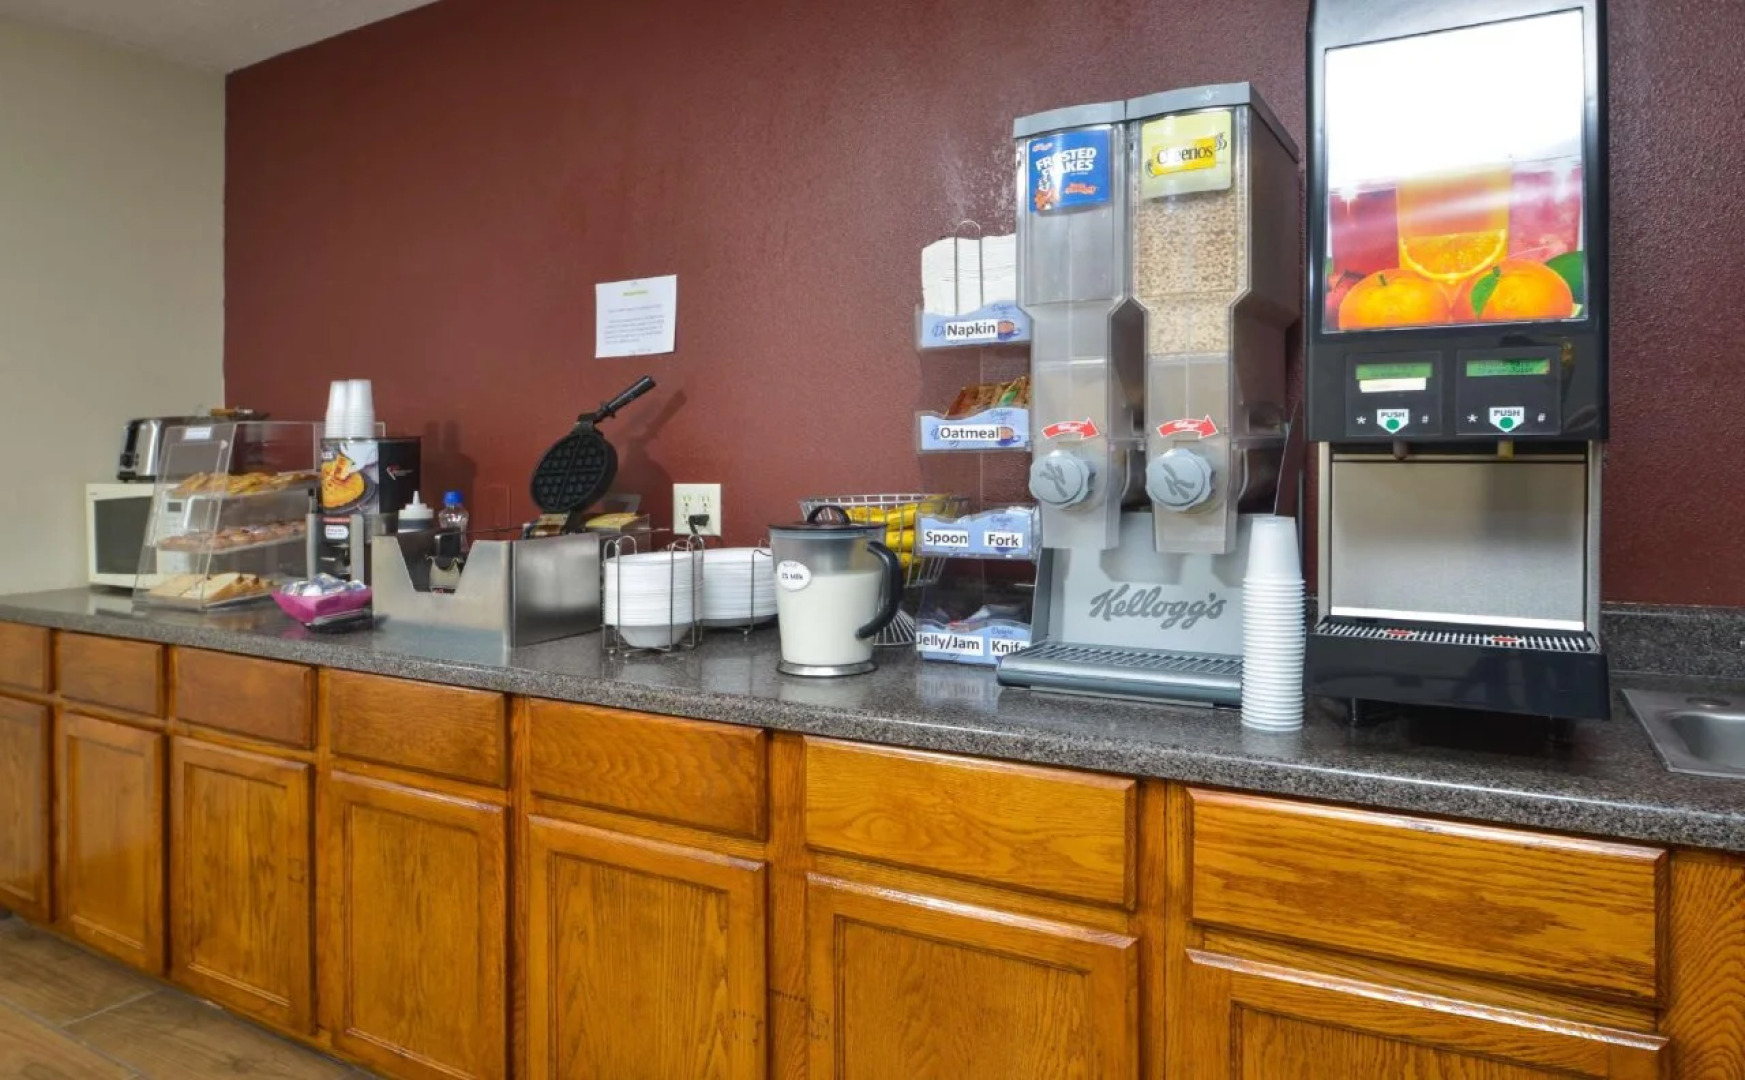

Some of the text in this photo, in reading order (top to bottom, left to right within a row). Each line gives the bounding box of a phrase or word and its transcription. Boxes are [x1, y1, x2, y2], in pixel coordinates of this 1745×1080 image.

[1157, 145, 1213, 164] Cerios
[947, 322, 996, 337] Napkin
[1493, 409, 1520, 417] PUSH
[940, 427, 999, 439] Oatmeal
[926, 532, 967, 545] Spoon
[988, 534, 1019, 546] Fork
[1089, 584, 1227, 630] Kellogg's
[917, 633, 980, 650] Jelly/Jam
